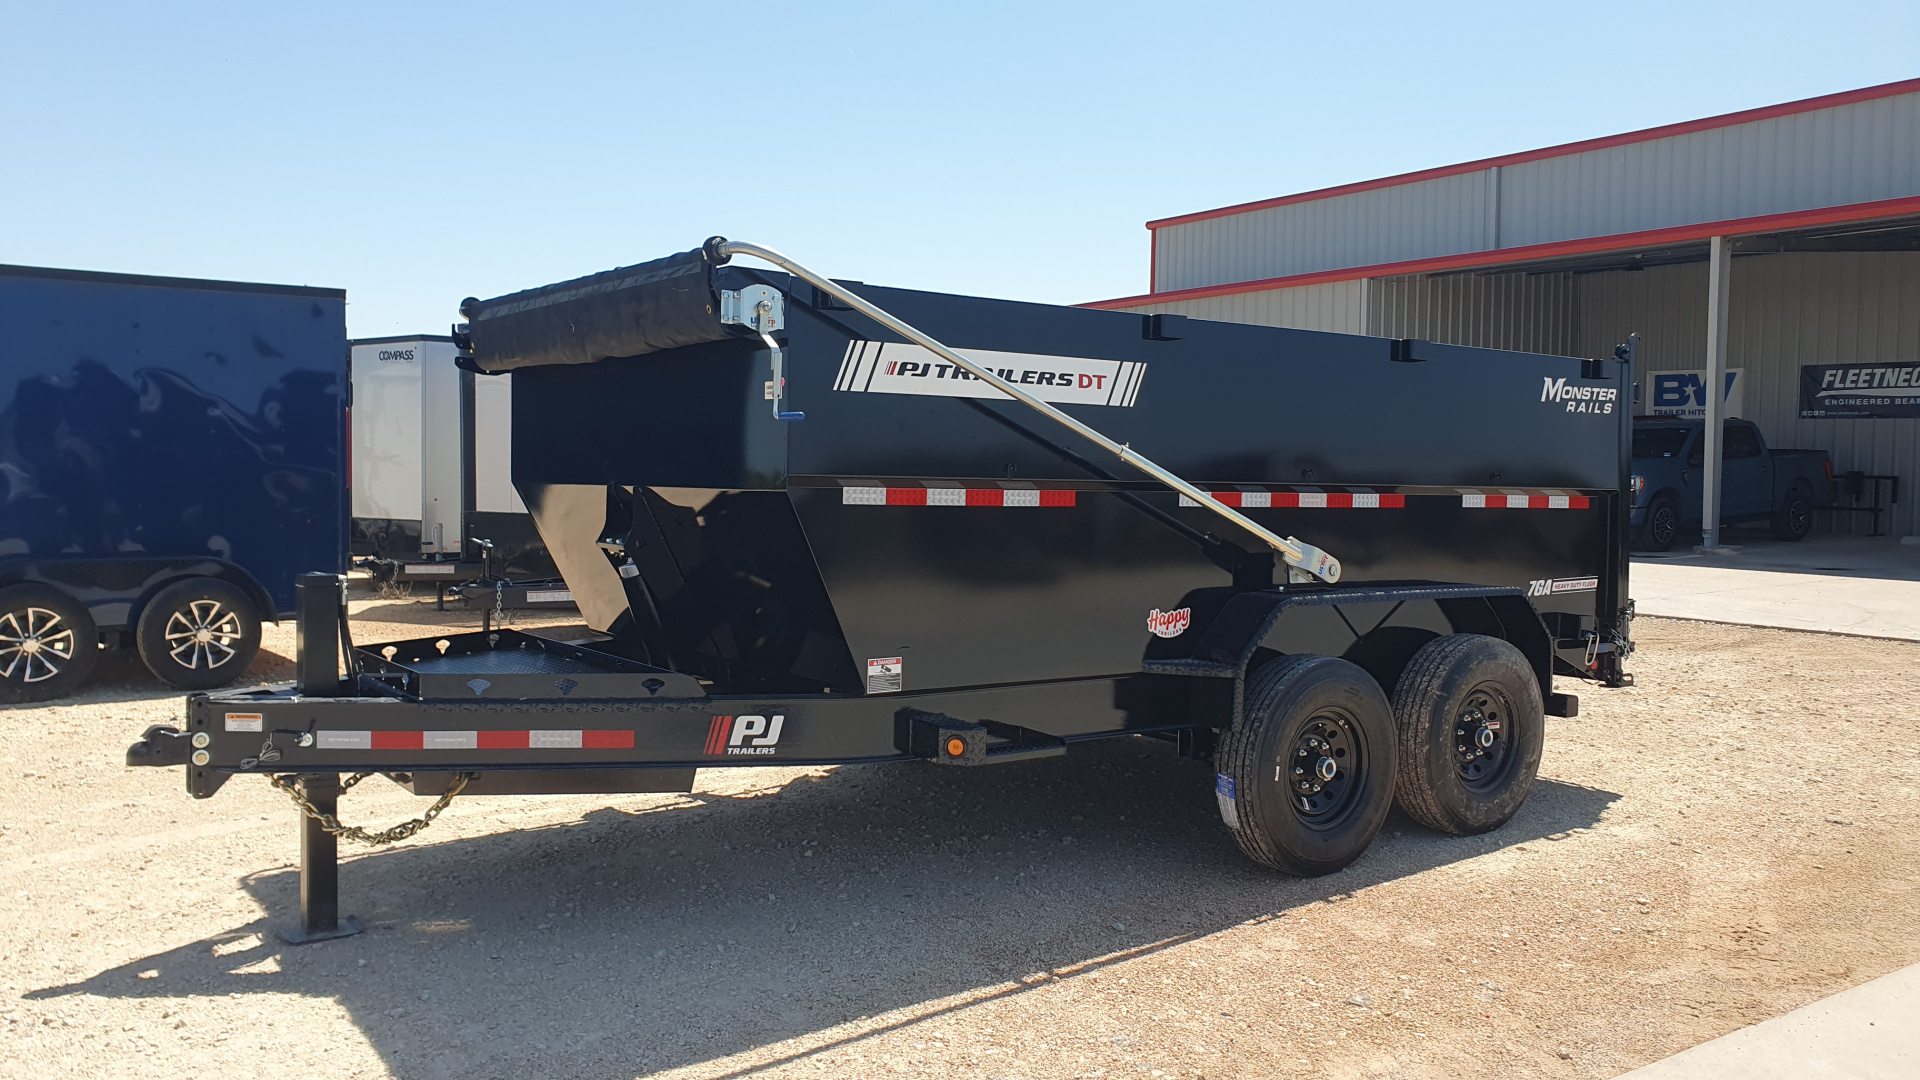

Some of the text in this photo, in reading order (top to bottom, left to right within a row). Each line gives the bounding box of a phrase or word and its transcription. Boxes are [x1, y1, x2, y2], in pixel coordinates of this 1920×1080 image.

[379, 350, 414, 361] COMPASS
[896, 361, 931, 377] PJ
[1078, 373, 1107, 390] DT
[1541, 376, 1617, 402] MONSTER
[1566, 401, 1613, 414] RAILS
[1824, 398, 1891, 406] ENGINEERED
[1654, 408, 1706, 417] TRAILER HITC
[1527, 579, 1552, 597] 7GA
[1554, 582, 1570, 590] HEAVY
[1149, 609, 1190, 631] Happy
[729, 715, 785, 746] PJ
[727, 747, 776, 755] TRAILERS
